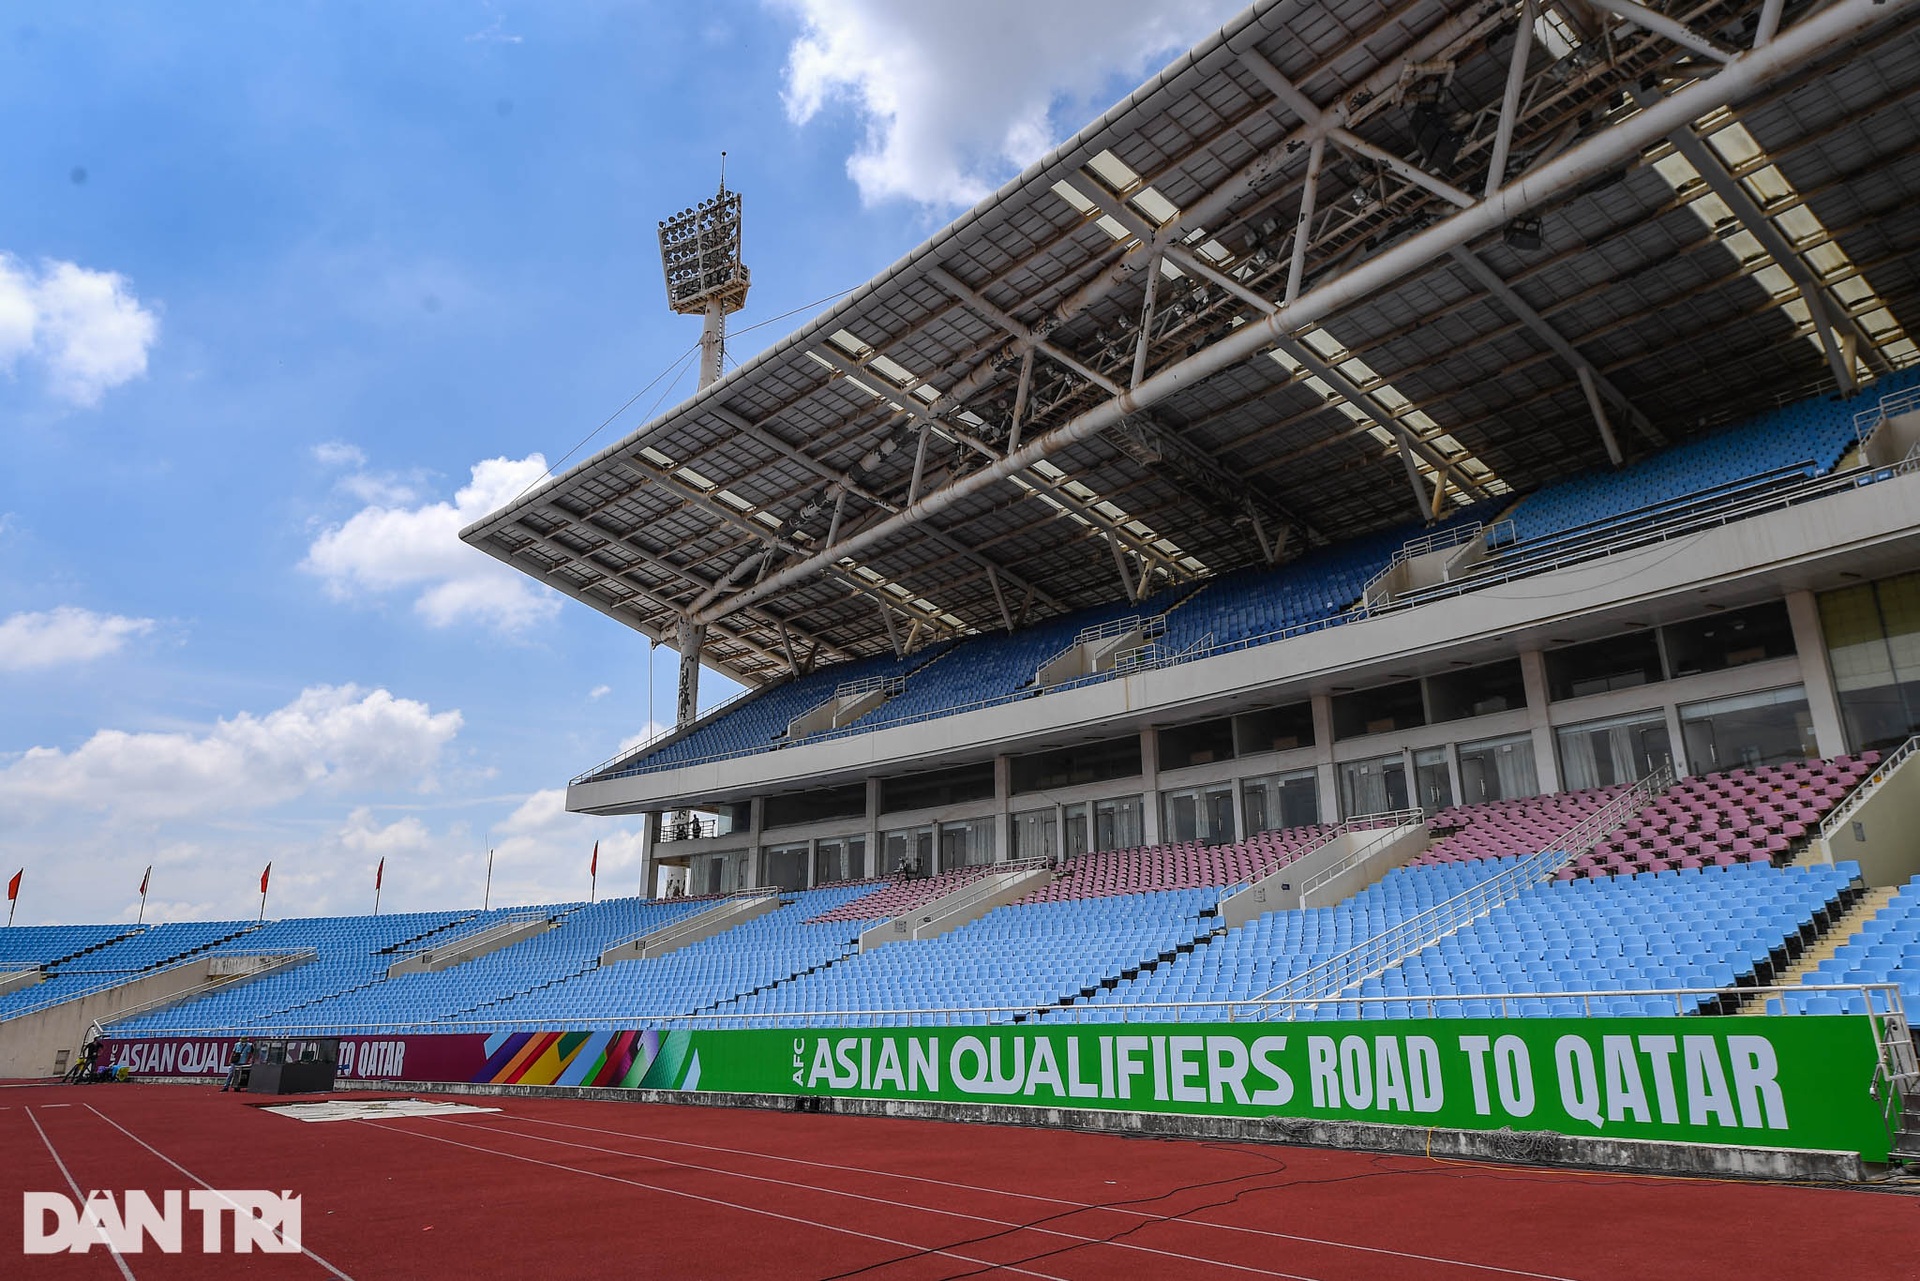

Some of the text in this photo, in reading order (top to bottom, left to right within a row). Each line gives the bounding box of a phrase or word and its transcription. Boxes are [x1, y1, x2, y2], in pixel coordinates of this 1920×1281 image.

[117, 1042, 177, 1073] ASIAN
[358, 1041, 406, 1079] QATAR
[792, 1037, 804, 1087] AFC
[807, 1034, 1790, 1130] ASIAN QUALIFIERS ROAD TO QATAR
